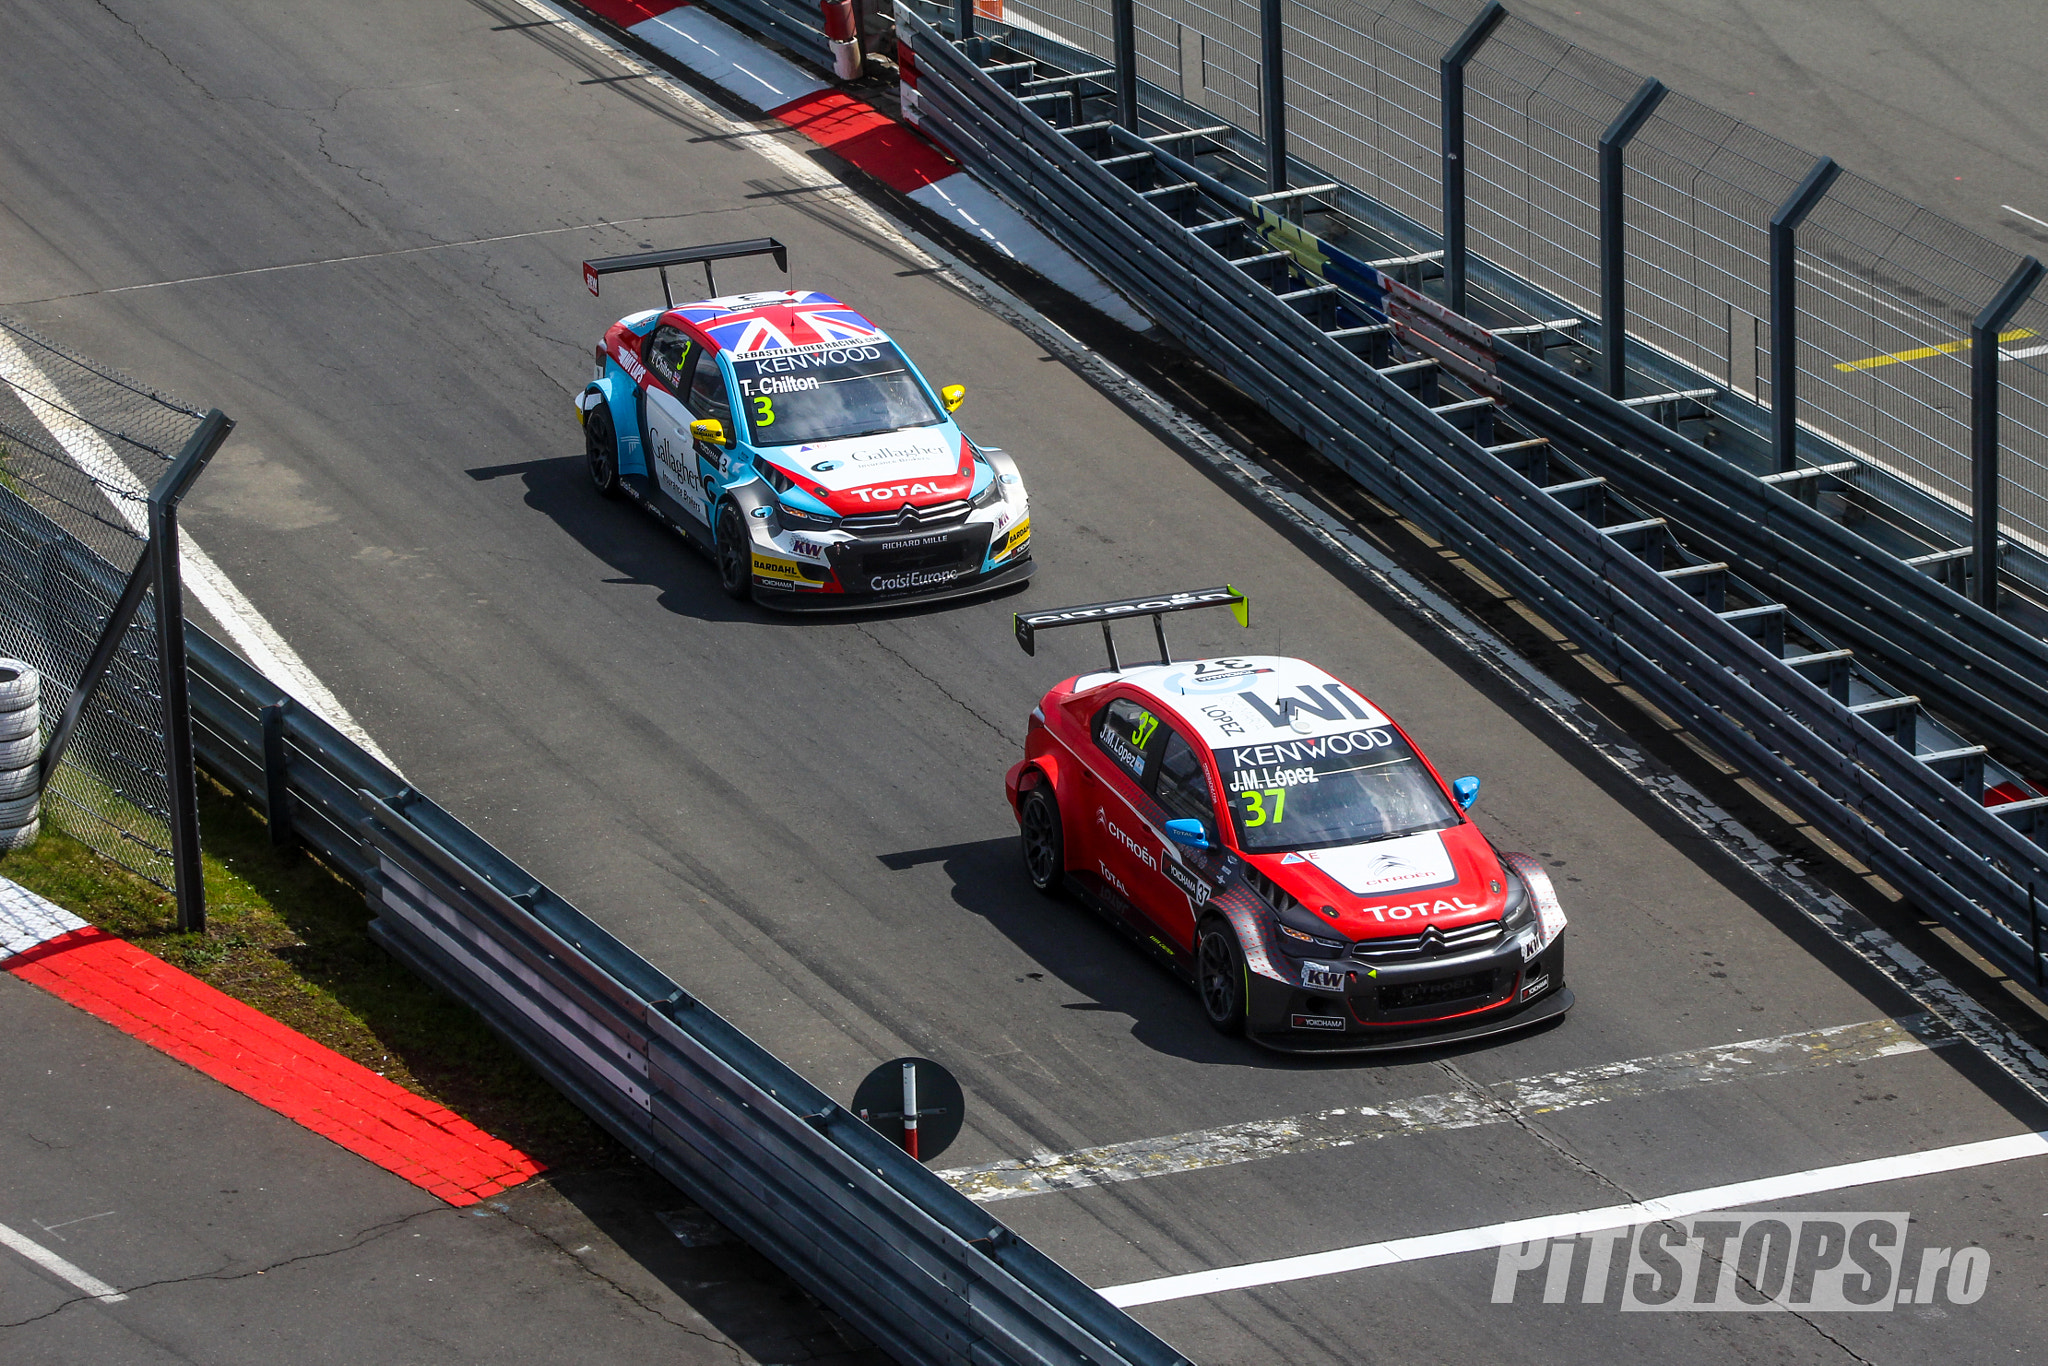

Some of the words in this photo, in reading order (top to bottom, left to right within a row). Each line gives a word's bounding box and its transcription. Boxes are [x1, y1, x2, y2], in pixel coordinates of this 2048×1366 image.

[676, 341, 691, 370] 3
[755, 346, 881, 375] KENWOOD
[740, 379, 754, 396] T.
[759, 376, 819, 395] Chilton
[753, 396, 775, 427] 3
[650, 427, 699, 491] Gallagher
[851, 444, 945, 462] Gallagher
[722, 458, 728, 473] 3
[851, 482, 950, 503] TOTAL
[793, 540, 822, 556] KW
[882, 540, 920, 550] RICHARD
[922, 535, 948, 545] MILLE
[754, 560, 797, 575] BARDAHL
[762, 579, 793, 589] YOKOHAMA
[870, 569, 958, 592] CroisiEurope
[1131, 711, 1158, 750] 37
[1232, 729, 1393, 767] KENWOOD
[1262, 765, 1319, 788] López
[1241, 788, 1286, 828] 37
[1173, 829, 1193, 837] TOTAL
[1108, 822, 1157, 872] CITROËN
[1099, 859, 1130, 897] TOTAL
[1170, 864, 1197, 894] YOKOHAMA
[1197, 882, 1210, 906] 37
[1363, 897, 1477, 922] TOTAL
[1308, 969, 1343, 987] KW
[1305, 1019, 1343, 1028] YOKOHAMA
